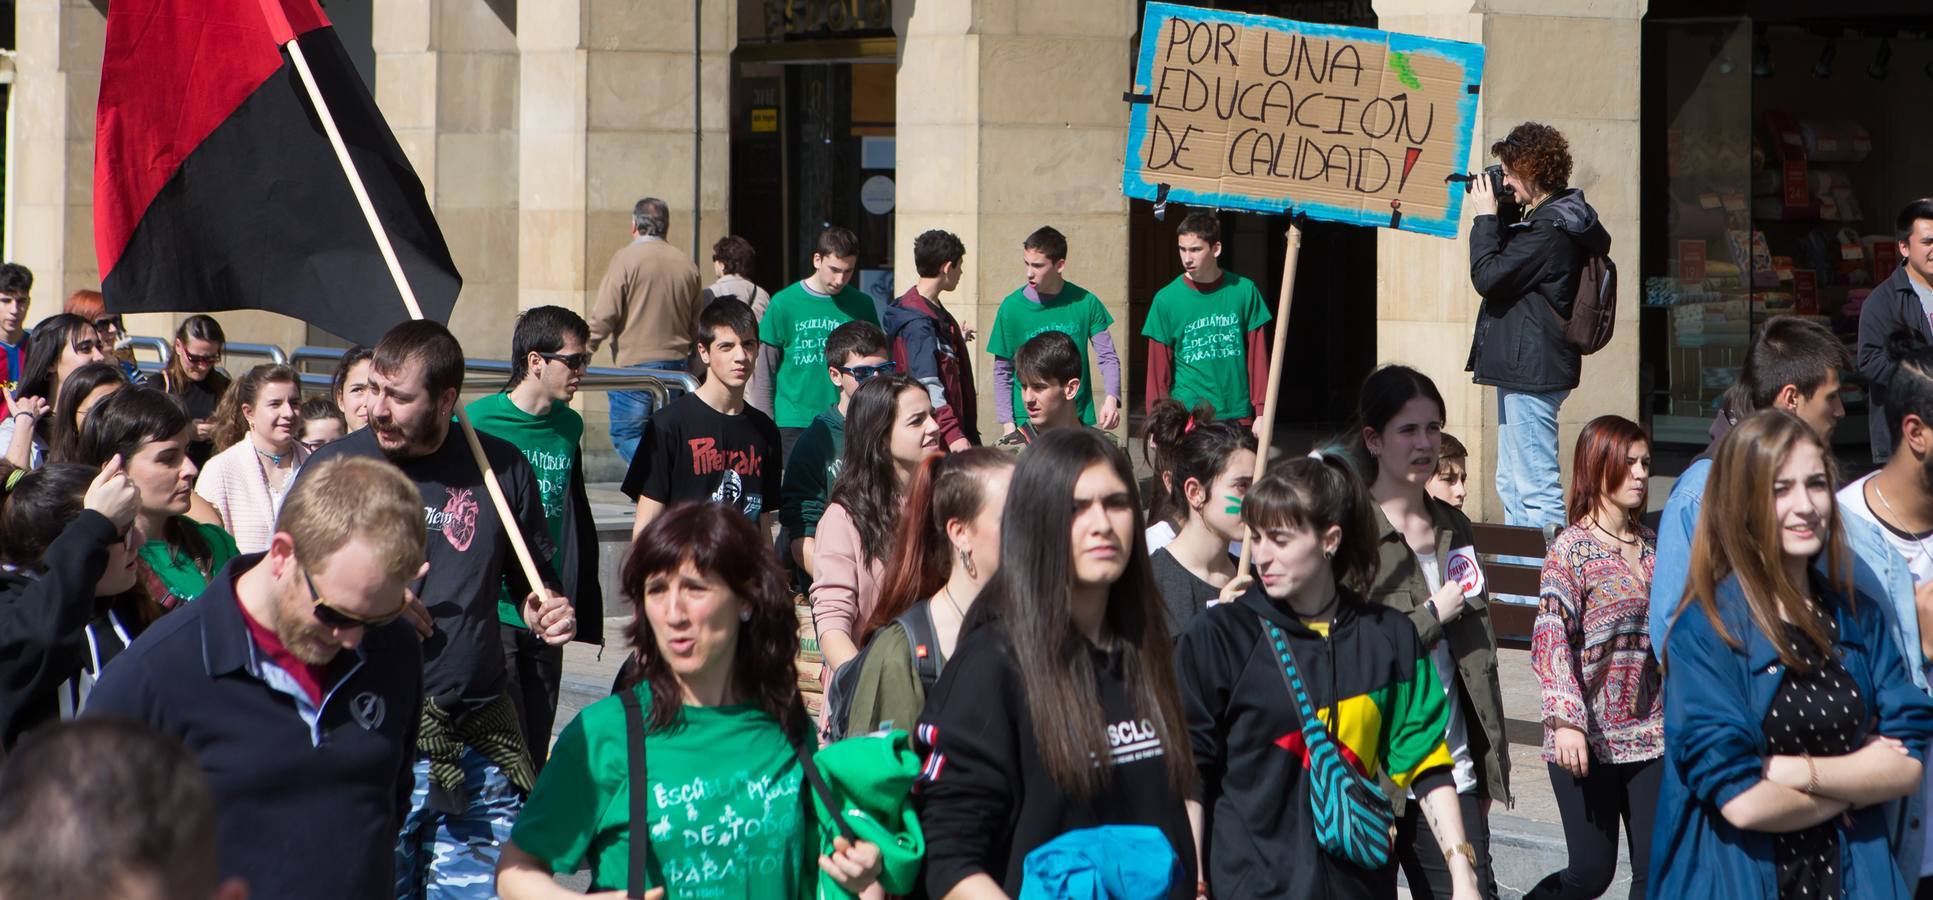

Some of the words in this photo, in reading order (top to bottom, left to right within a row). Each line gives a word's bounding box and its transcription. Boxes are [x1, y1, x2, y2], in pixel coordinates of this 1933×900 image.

[1166, 15, 1239, 67] POR
[1263, 31, 1364, 86] UNA
[1155, 66, 1434, 145] EDUCACIÓN
[1147, 114, 1204, 171] DE
[682, 825, 715, 848] DE
